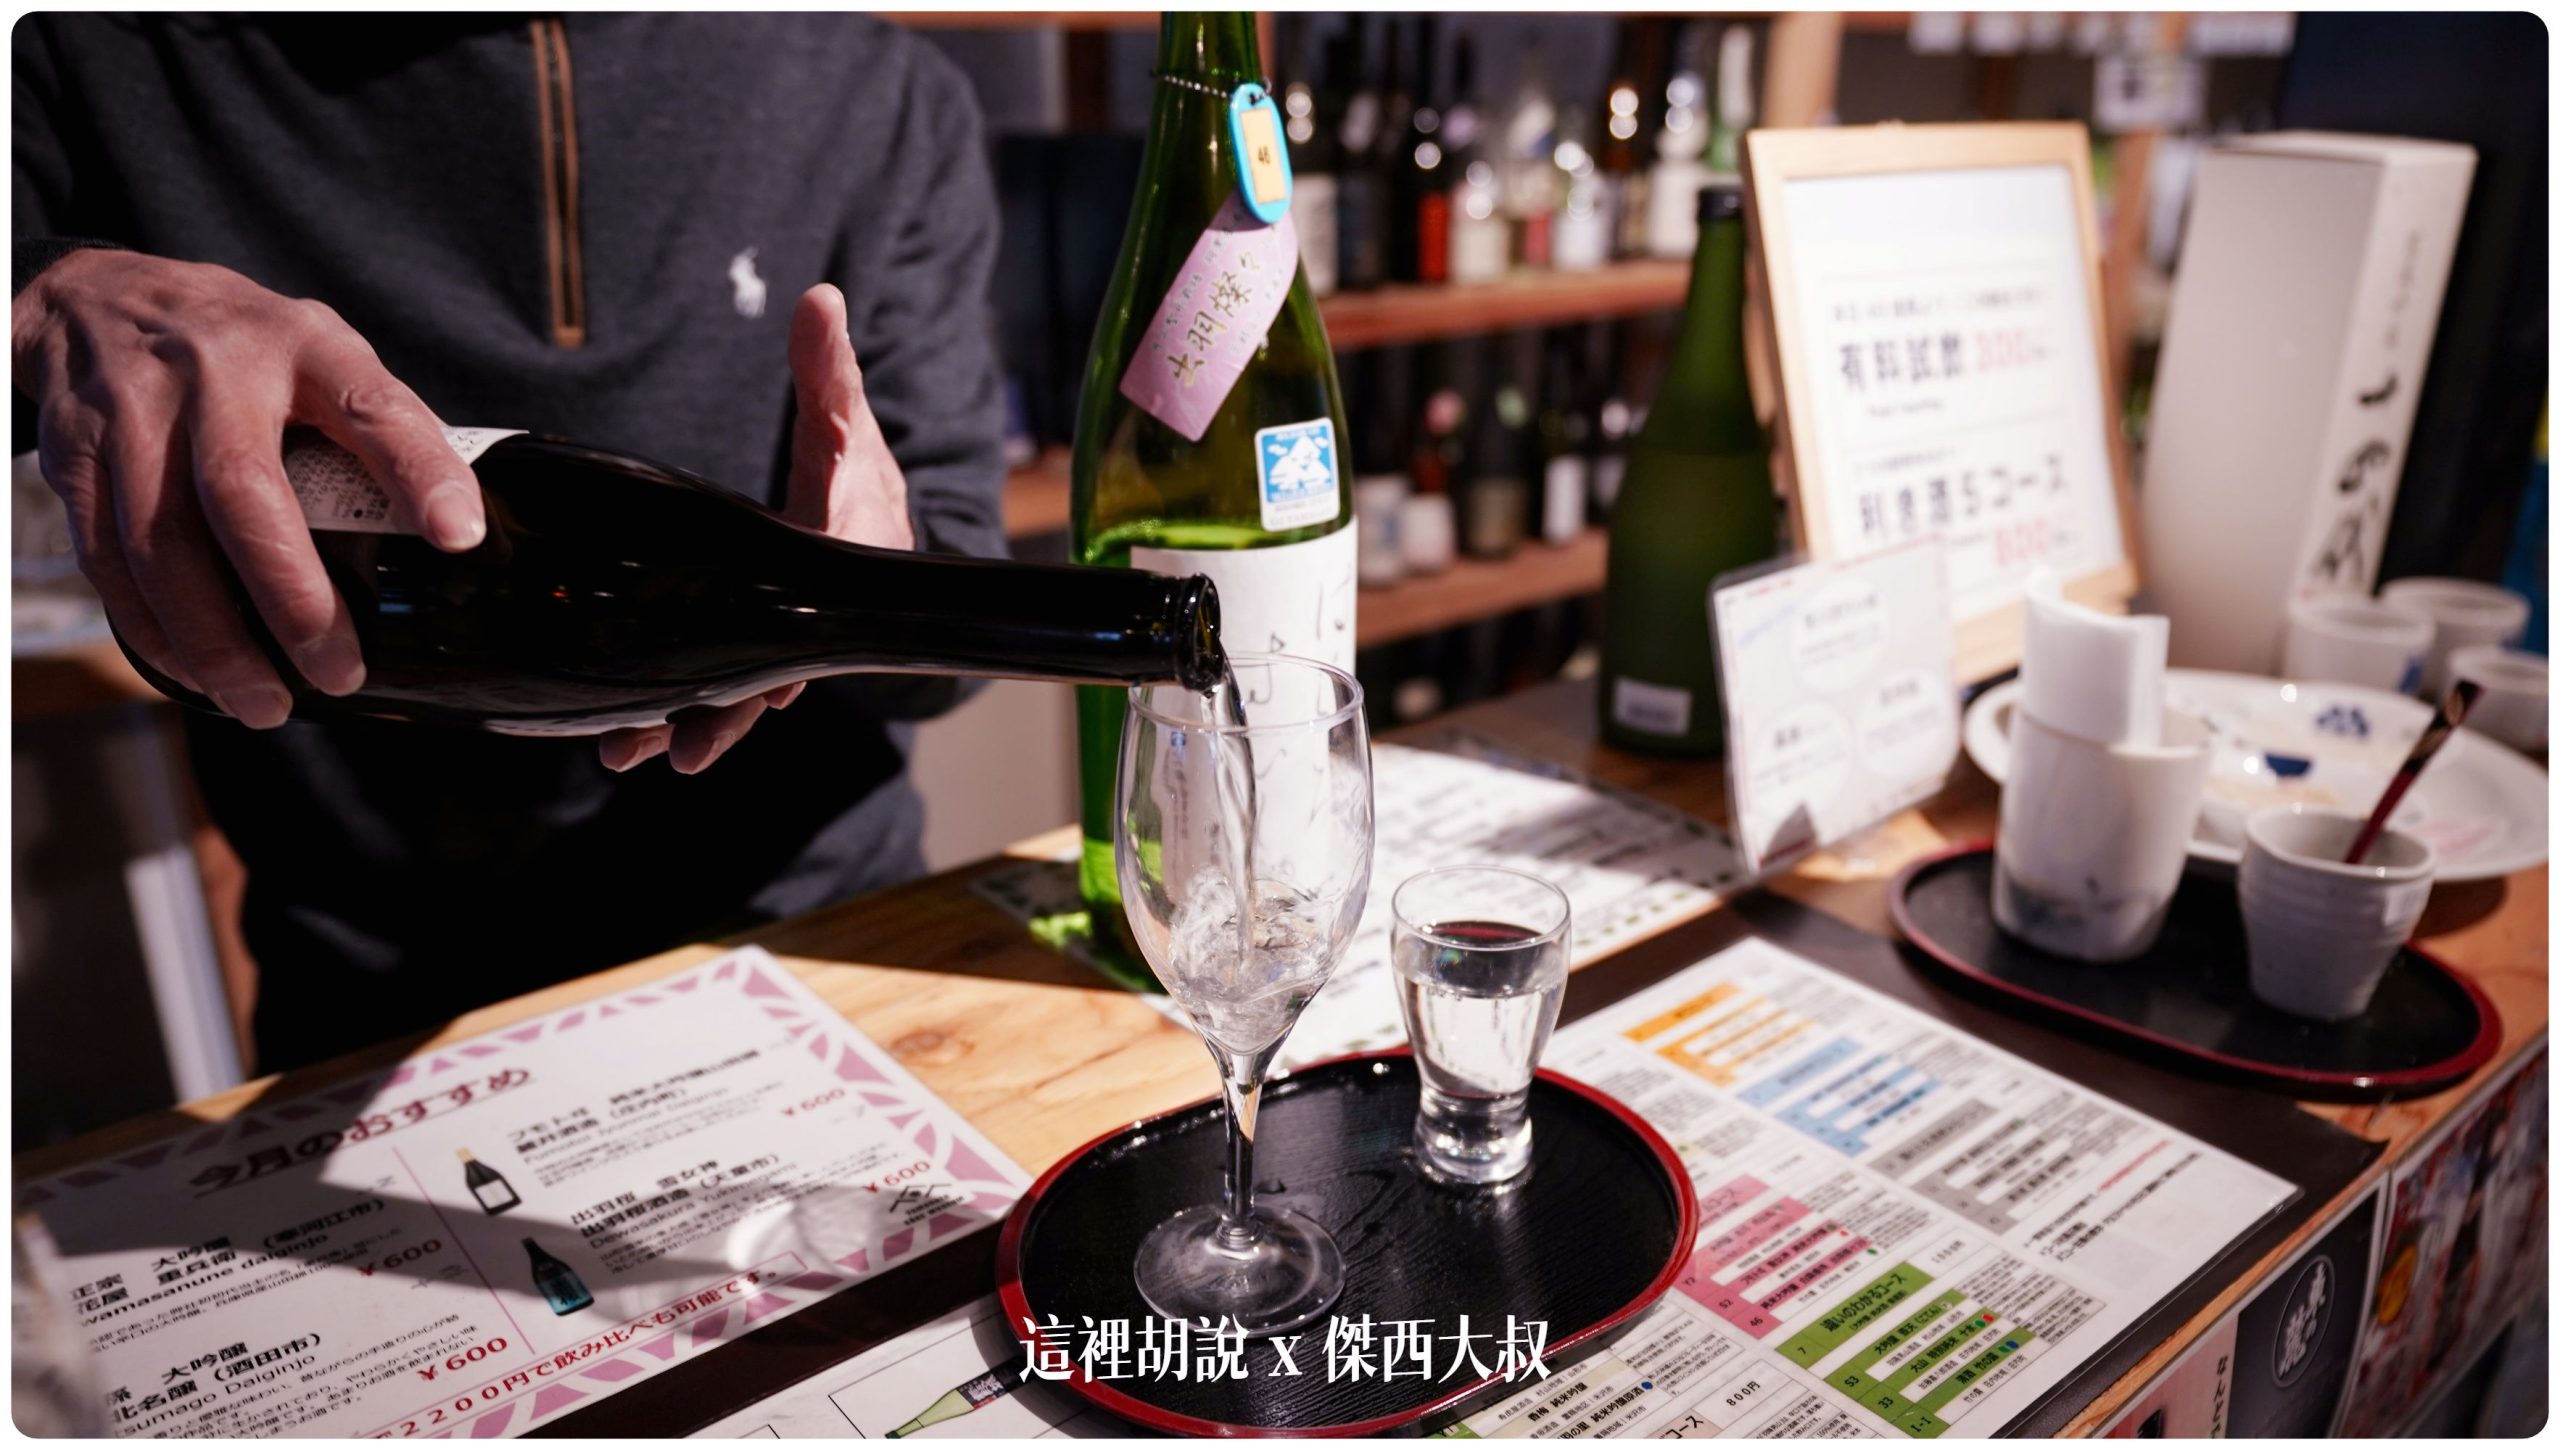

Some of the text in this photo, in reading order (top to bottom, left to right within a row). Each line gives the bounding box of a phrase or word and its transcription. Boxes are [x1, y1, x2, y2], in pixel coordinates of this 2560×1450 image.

[189, 1069, 530, 1190] 今月のおすすめ
[862, 1159, 932, 1195] ¥600
[570, 1190, 636, 1226] 出羽桜
[579, 1187, 691, 1239] 出羽桜酒造
[355, 1238, 444, 1277] ¥600
[1719, 1299, 1733, 1311] S2
[1760, 1283, 1800, 1311] 純米大吟醸
[1749, 1316, 1764, 1328] 46
[161, 1341, 249, 1385] 大吟醸
[214, 1332, 321, 1383] （酒田市）
[224, 1353, 316, 1395] Daiginjo
[416, 1336, 509, 1382] ¥600
[1909, 1358, 1927, 1375] 大山
[1926, 1335, 1959, 1361] 特別純米
[1550, 1381, 1588, 1408] 純米吟醸
[1843, 1375, 1861, 1389] S3
[1555, 1385, 1645, 1439] 羽の里 純米吟醸原酒
[1658, 1379, 1761, 1439] コース 800円
[1877, 1395, 1895, 1410] 33
